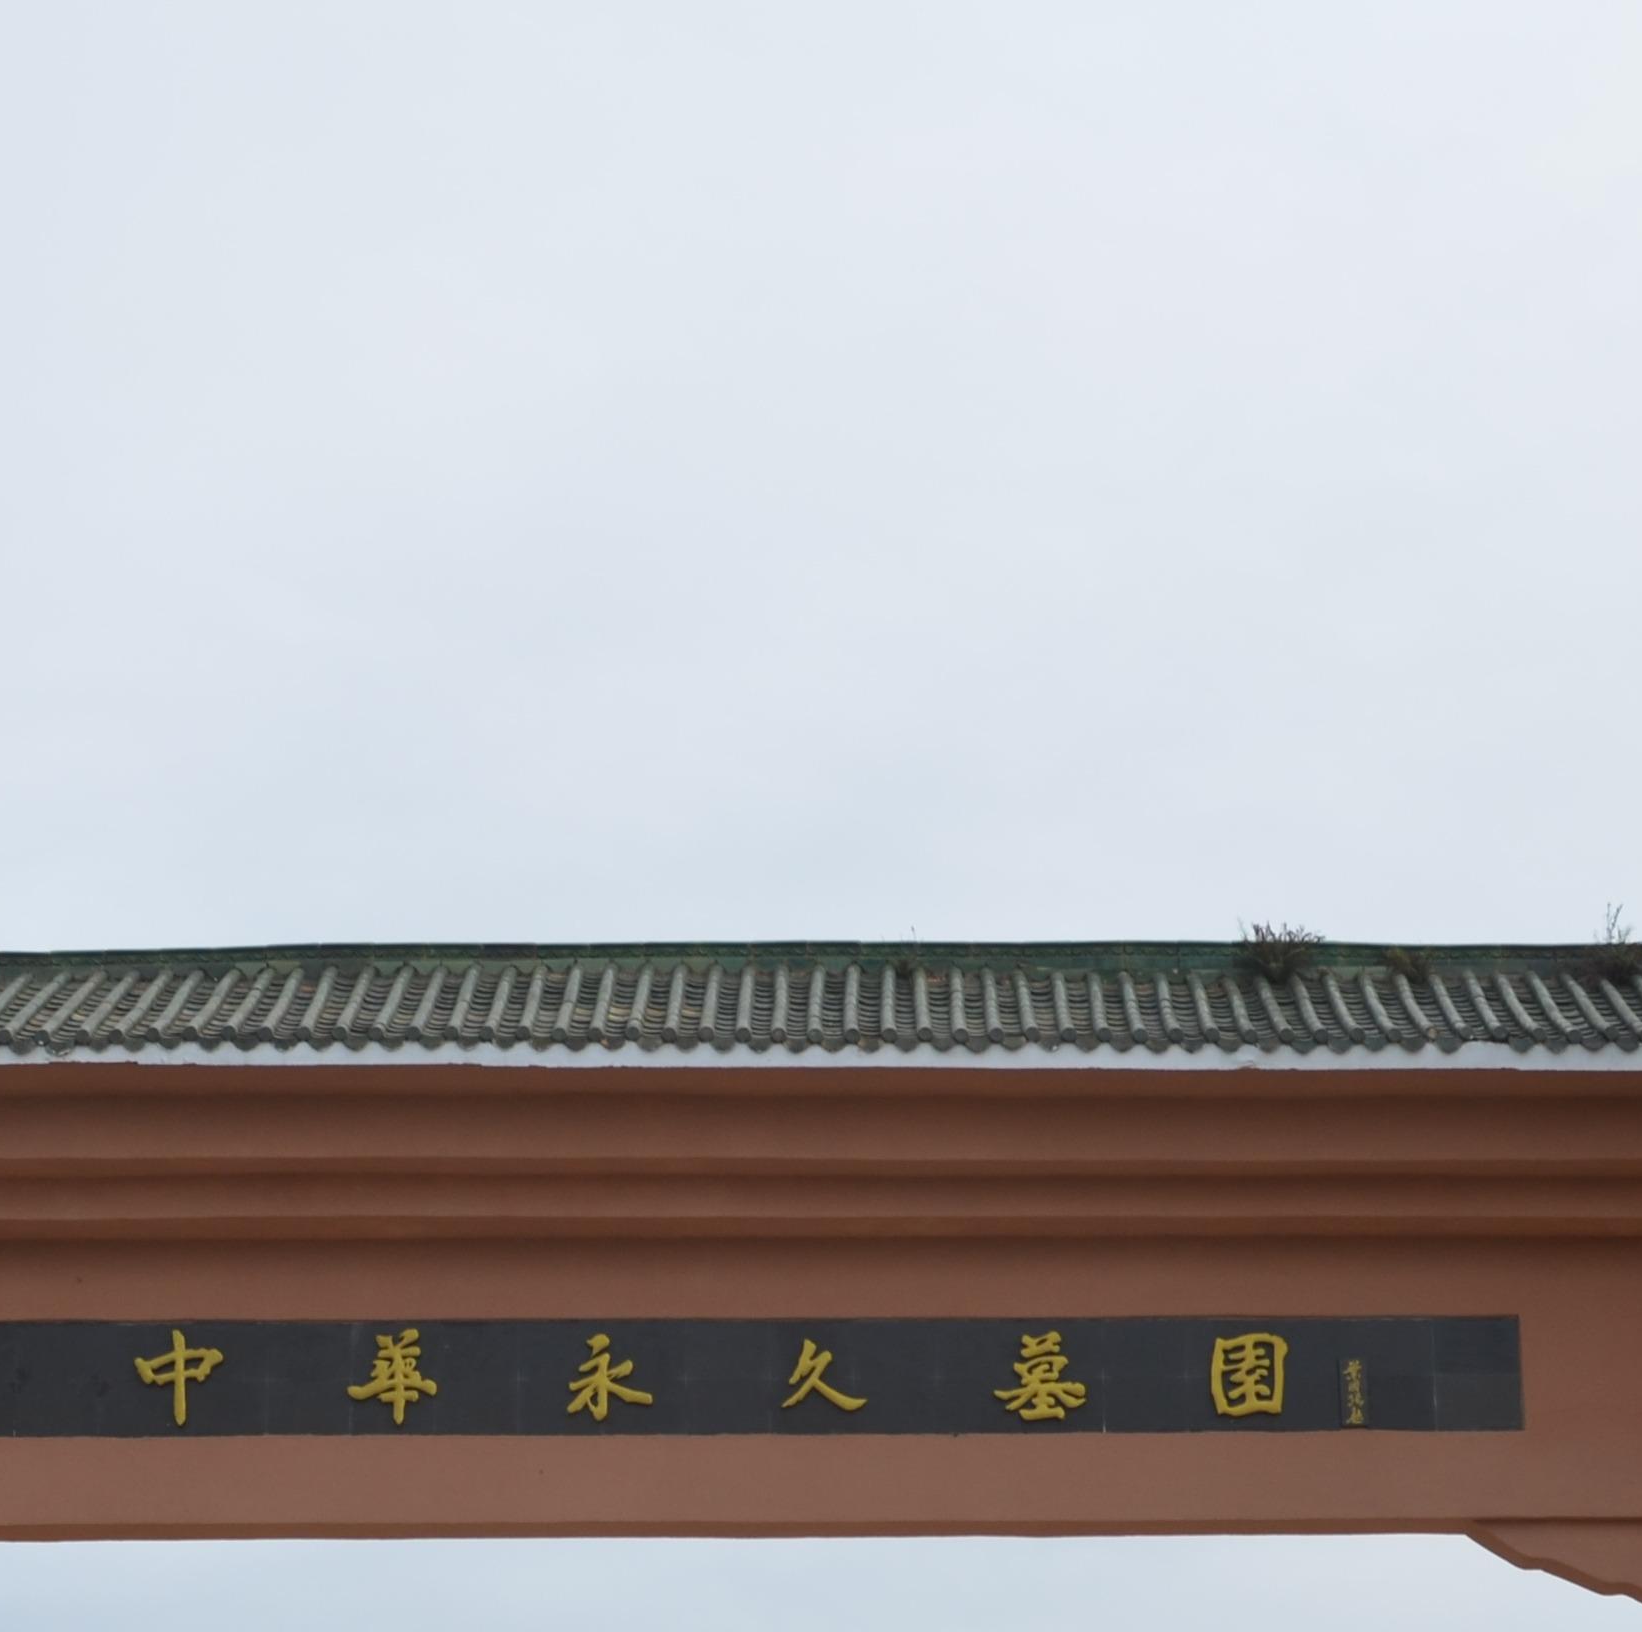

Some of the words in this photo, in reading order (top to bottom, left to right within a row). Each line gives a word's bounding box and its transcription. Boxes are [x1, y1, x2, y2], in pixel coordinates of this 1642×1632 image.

[135, 1328, 1289, 1425] 中華永久墓園
